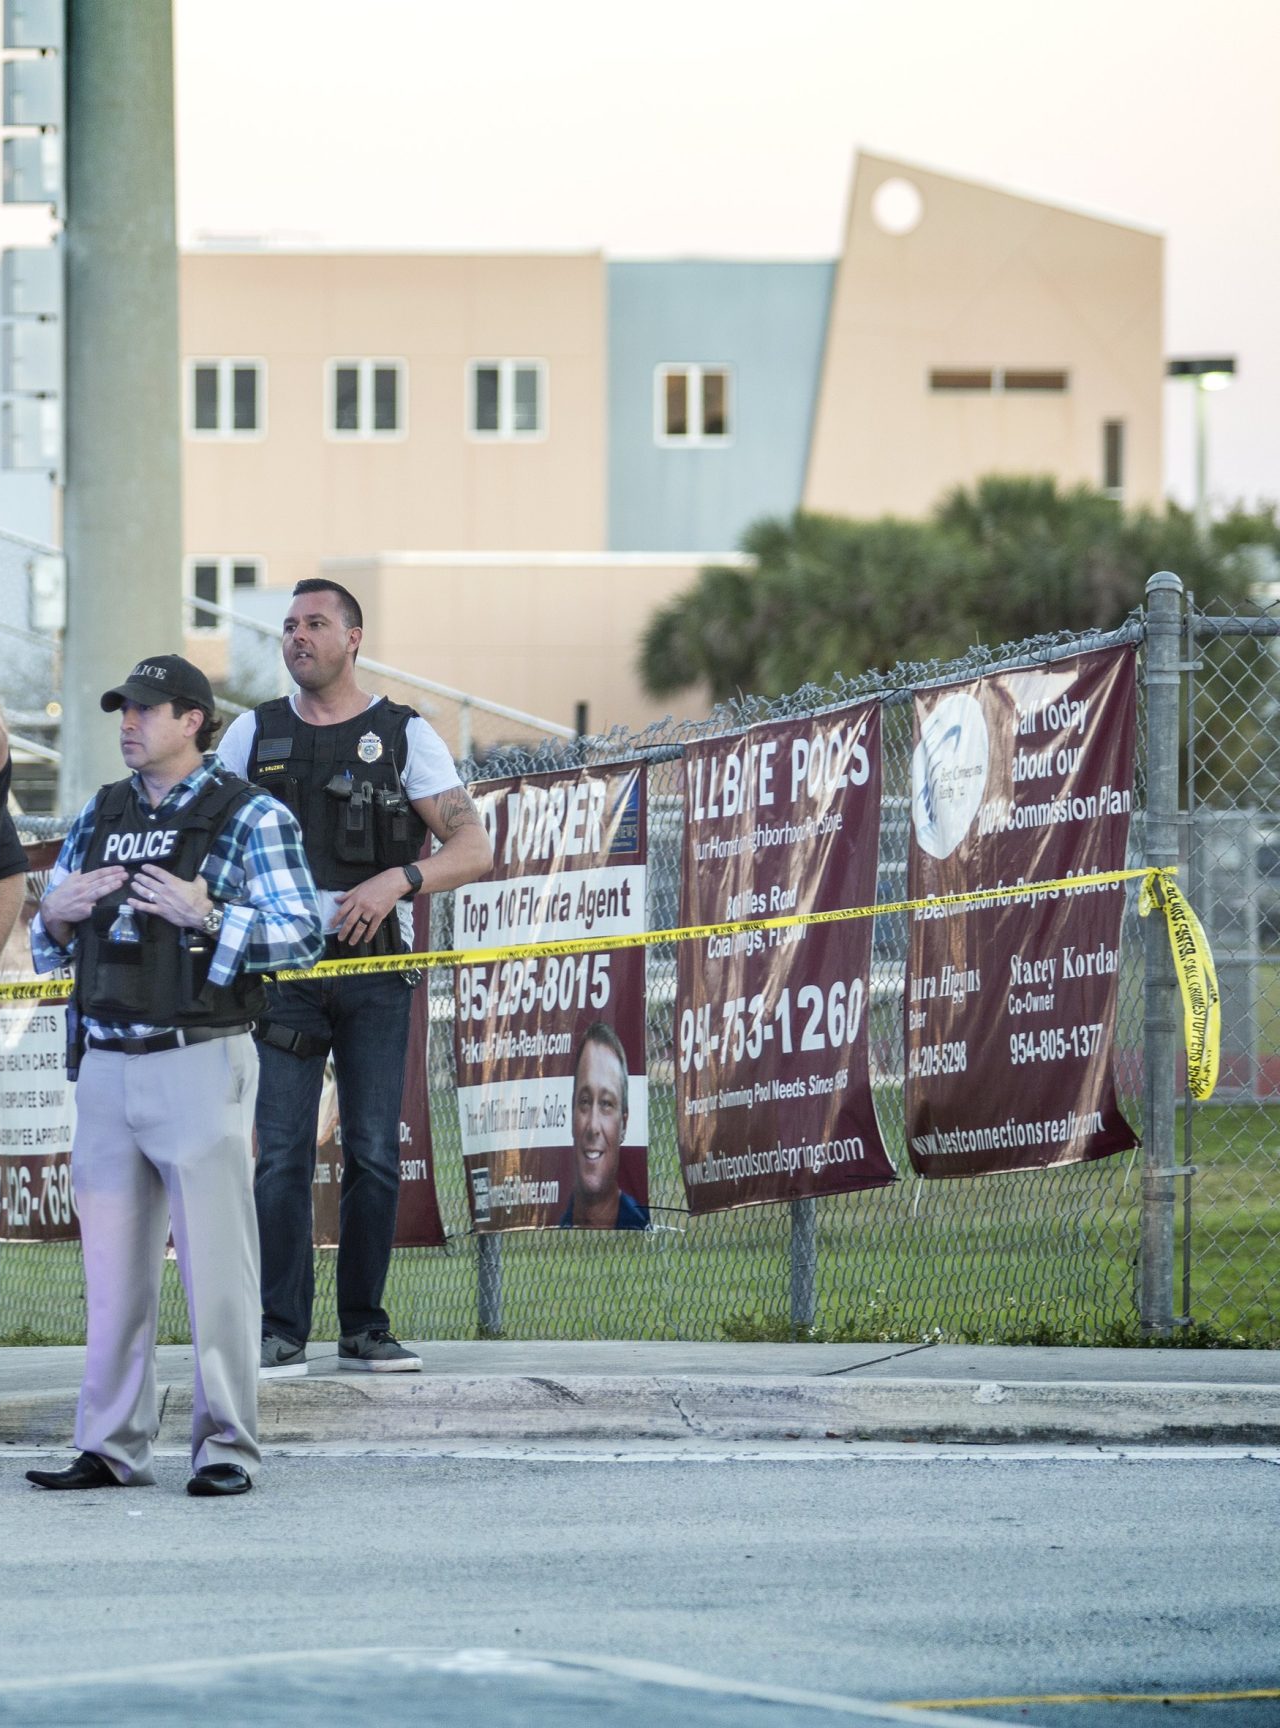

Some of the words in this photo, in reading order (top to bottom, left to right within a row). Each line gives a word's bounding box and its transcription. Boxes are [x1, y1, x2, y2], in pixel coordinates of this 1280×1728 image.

[1042, 694, 1090, 735] Today
[1012, 748, 1053, 782] about
[1057, 746, 1085, 773] our
[1007, 791, 1097, 832] Commission
[1099, 784, 1131, 818] Plan
[103, 830, 178, 861] POLICE
[463, 894, 489, 942] Top
[575, 878, 631, 930] Agent
[770, 882, 798, 912] Road
[1010, 954, 1057, 990] Stacey
[1008, 991, 1055, 1016] Co-Owner
[1188, 981, 1208, 1062] CRIMESTOPPERS
[33, 1052, 58, 1071] CARE
[1010, 1022, 1104, 1066] 954-805-1377
[754, 1081, 771, 1102] Pool
[772, 1076, 807, 1101] Needs
[808, 1074, 834, 1096] Since
[541, 1093, 567, 1129] Sales
[399, 1122, 413, 1145] Dr,
[400, 1159, 428, 1180] 33071
